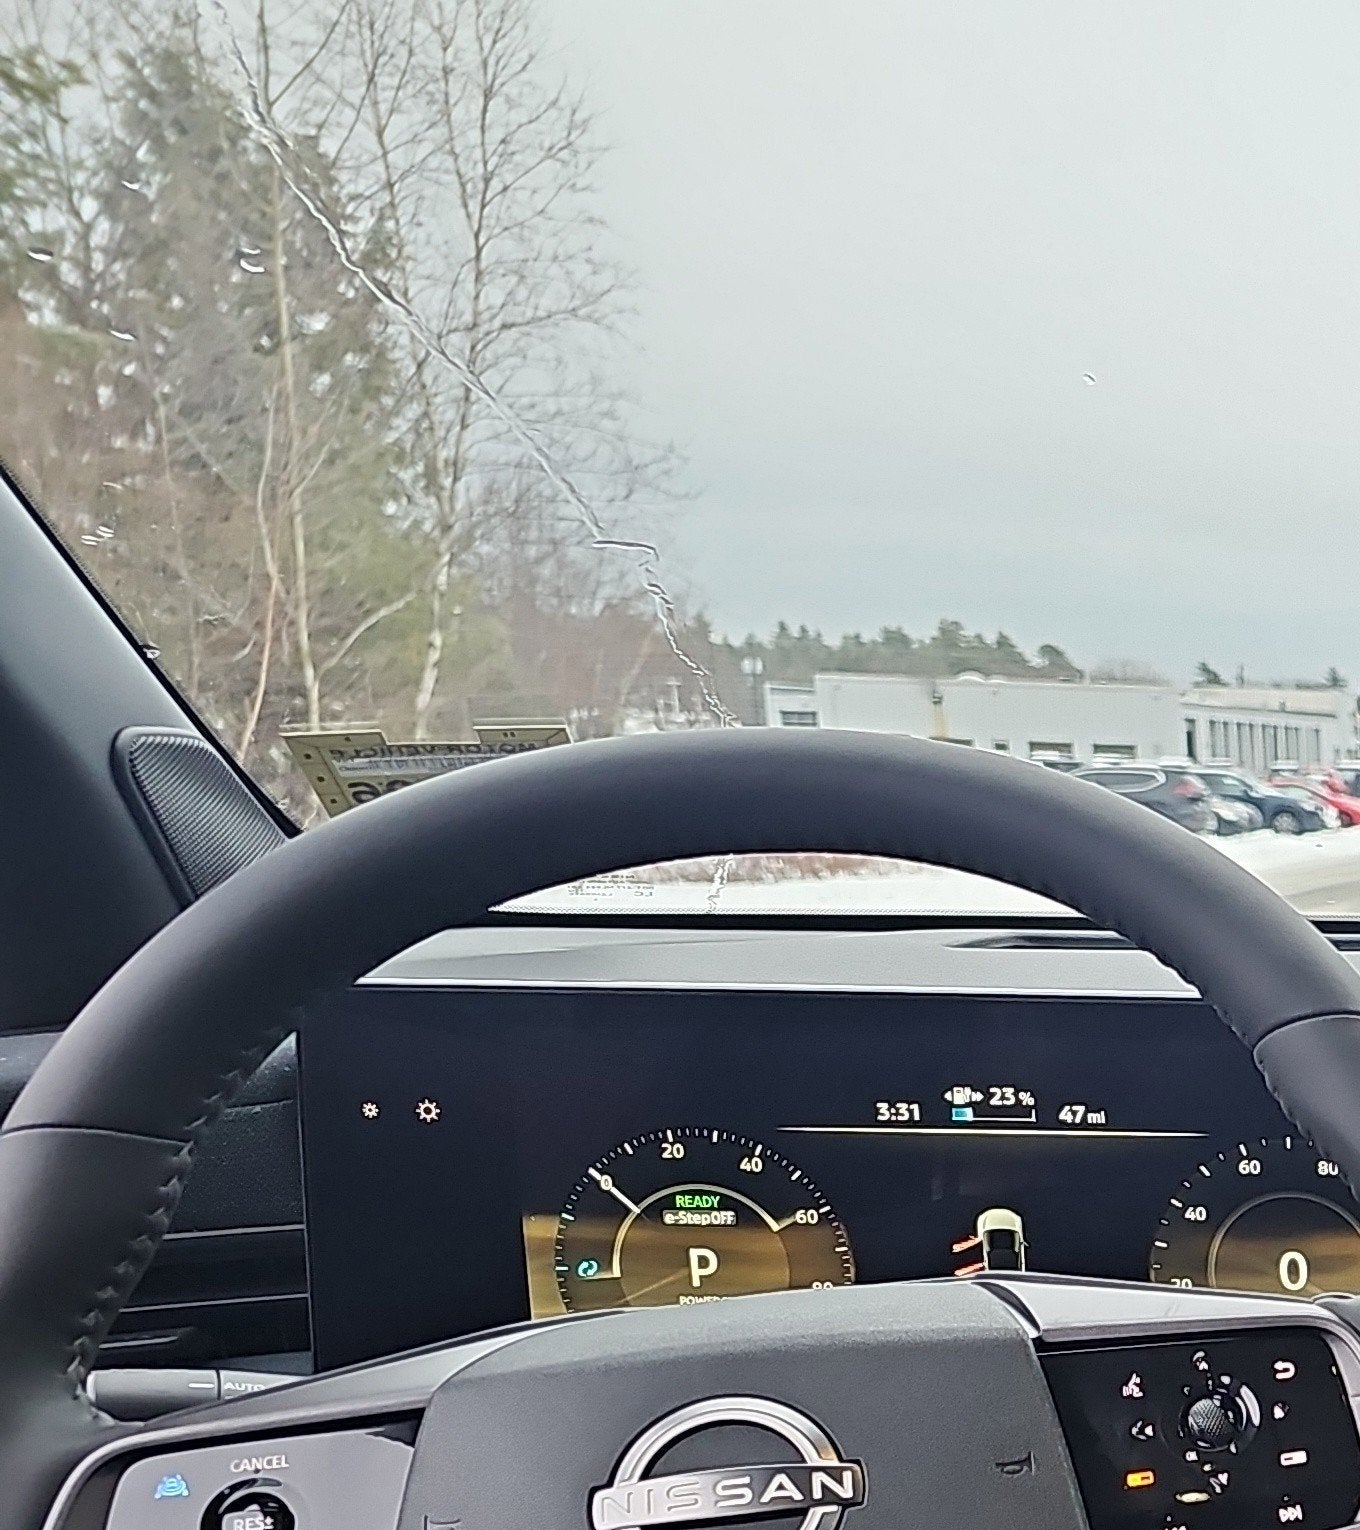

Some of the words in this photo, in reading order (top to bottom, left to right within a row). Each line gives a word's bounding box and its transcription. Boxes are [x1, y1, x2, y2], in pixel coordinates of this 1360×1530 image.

[989, 1088, 1016, 1105] 23
[1019, 1092, 1034, 1105] %
[876, 1103, 920, 1121] 3:31
[1058, 1106, 1085, 1124] 47
[1087, 1110, 1105, 1124] mi
[661, 1143, 685, 1160] 20
[740, 1157, 763, 1173] 40
[1238, 1160, 1261, 1175] 60
[1317, 1160, 1339, 1176] 80
[600, 1175, 613, 1191] 0
[675, 1195, 720, 1208] READY
[797, 1209, 819, 1225] 60
[1185, 1206, 1207, 1222] 40
[689, 1248, 717, 1287] P
[1279, 1251, 1308, 1290] 0
[230, 1455, 289, 1473] CANCEL
[601, 1470, 853, 1523] NISSAN
